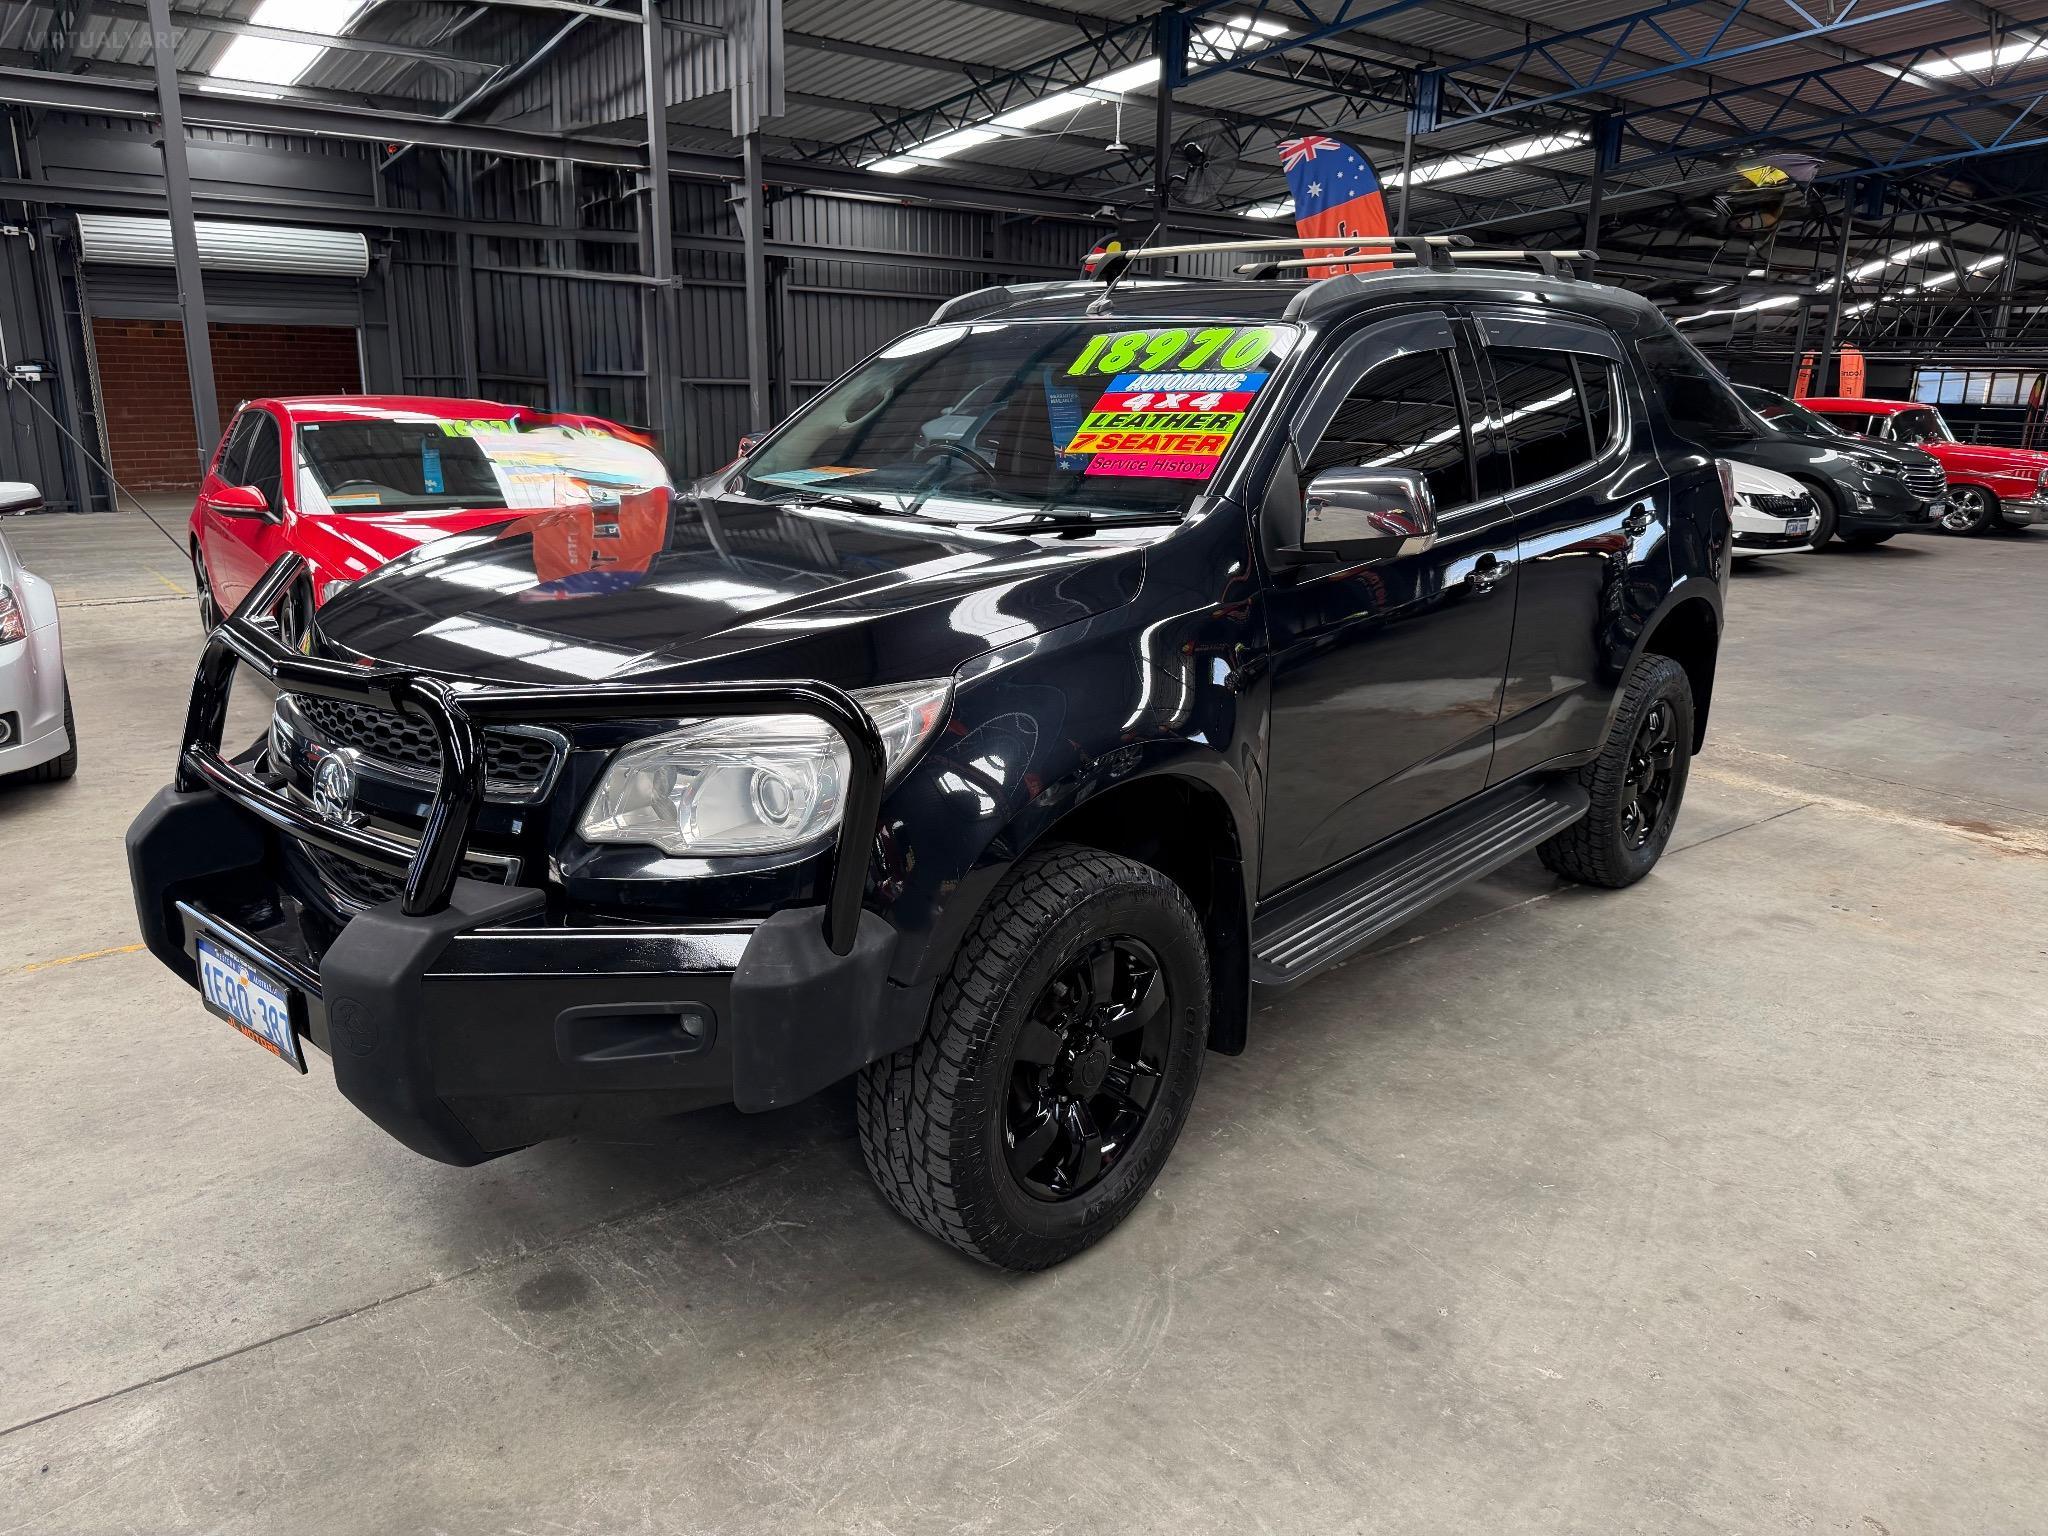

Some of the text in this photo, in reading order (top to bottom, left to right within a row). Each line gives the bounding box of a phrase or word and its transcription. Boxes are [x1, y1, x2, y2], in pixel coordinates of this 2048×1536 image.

[1067, 328, 1273, 376] 18970
[1125, 374, 1247, 391] AUTOMATIC
[1088, 413, 1236, 431] LEATHER
[1071, 434, 1228, 453] 7 SEATER
[1092, 456, 1210, 475] Service History
[241, 1024, 281, 1057] MOTORS
